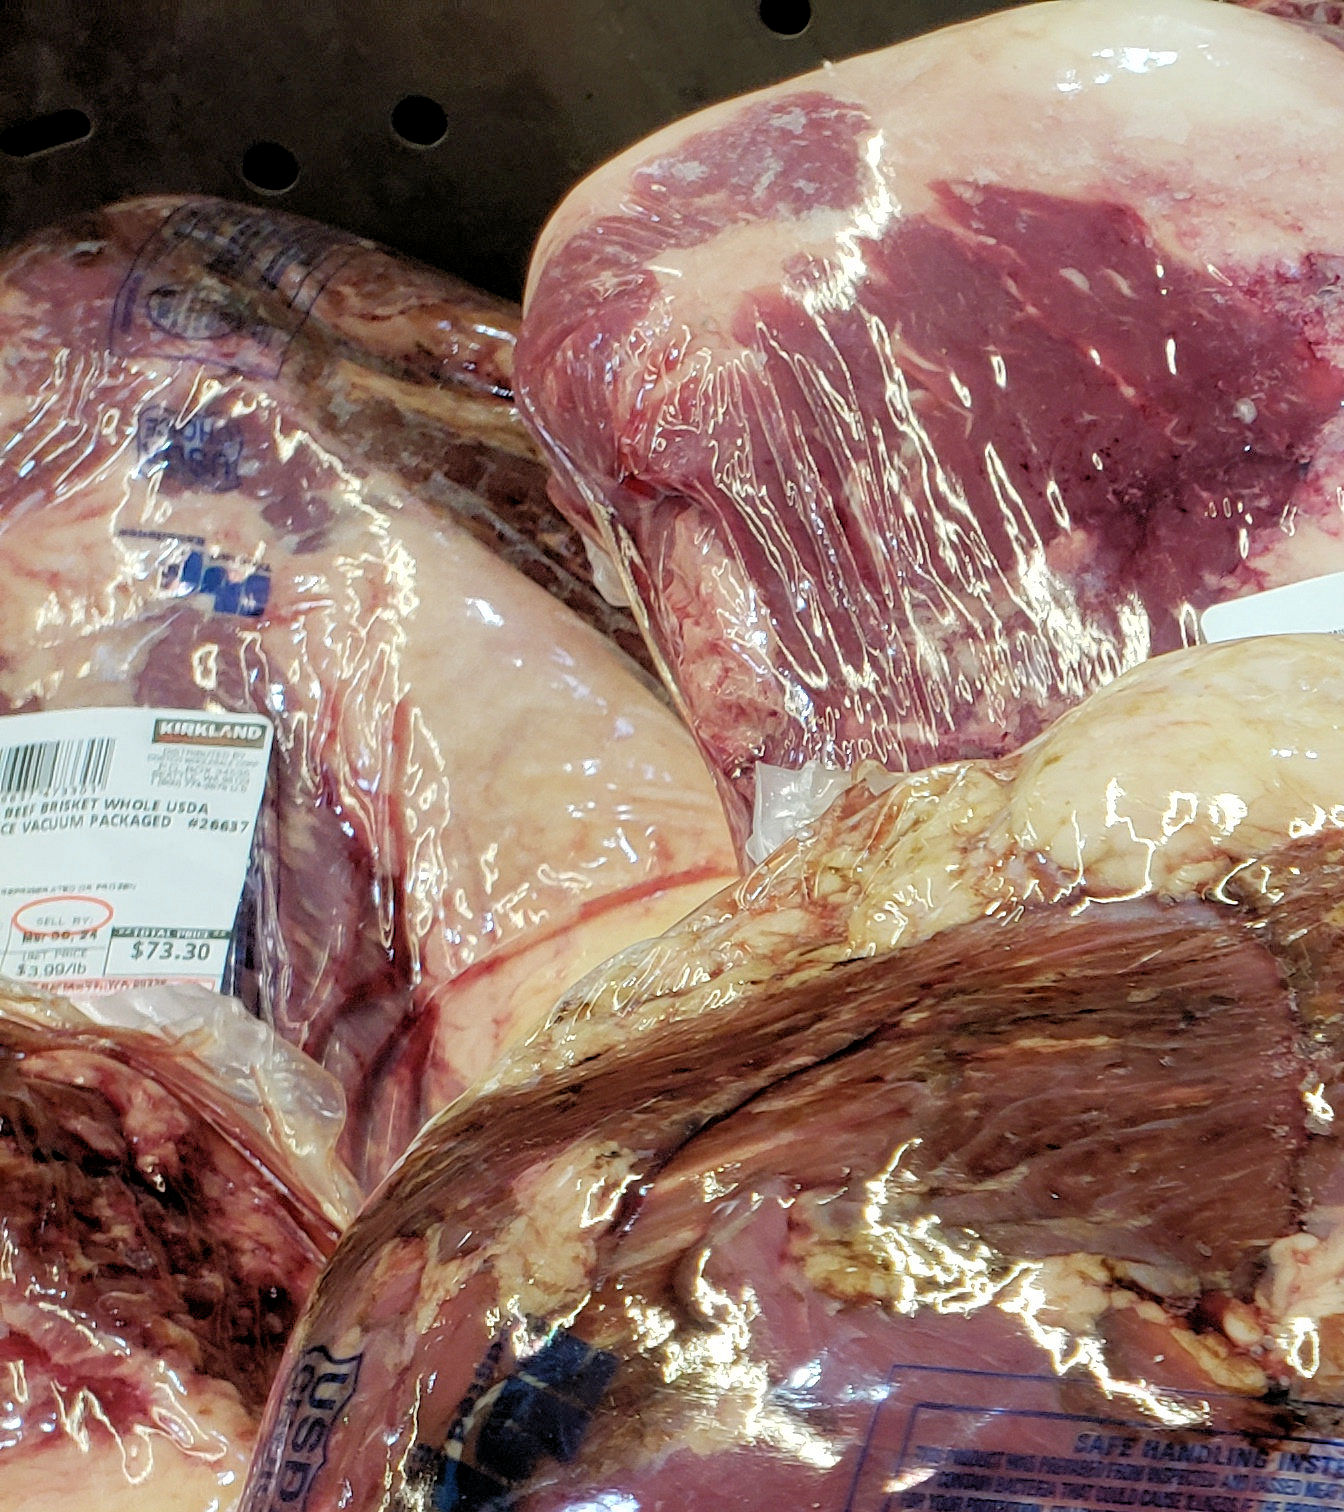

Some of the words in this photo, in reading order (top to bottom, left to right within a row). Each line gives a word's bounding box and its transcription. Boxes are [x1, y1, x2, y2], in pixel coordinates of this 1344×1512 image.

[159, 721, 263, 741] KIRKLAND
[40, 800, 97, 814] BRISKET
[104, 799, 158, 812] WHOLE
[167, 801, 209, 815] USDA
[23, 816, 84, 834] VACUUM
[90, 815, 172, 829] PACKAGED
[131, 941, 210, 961] $73.30
